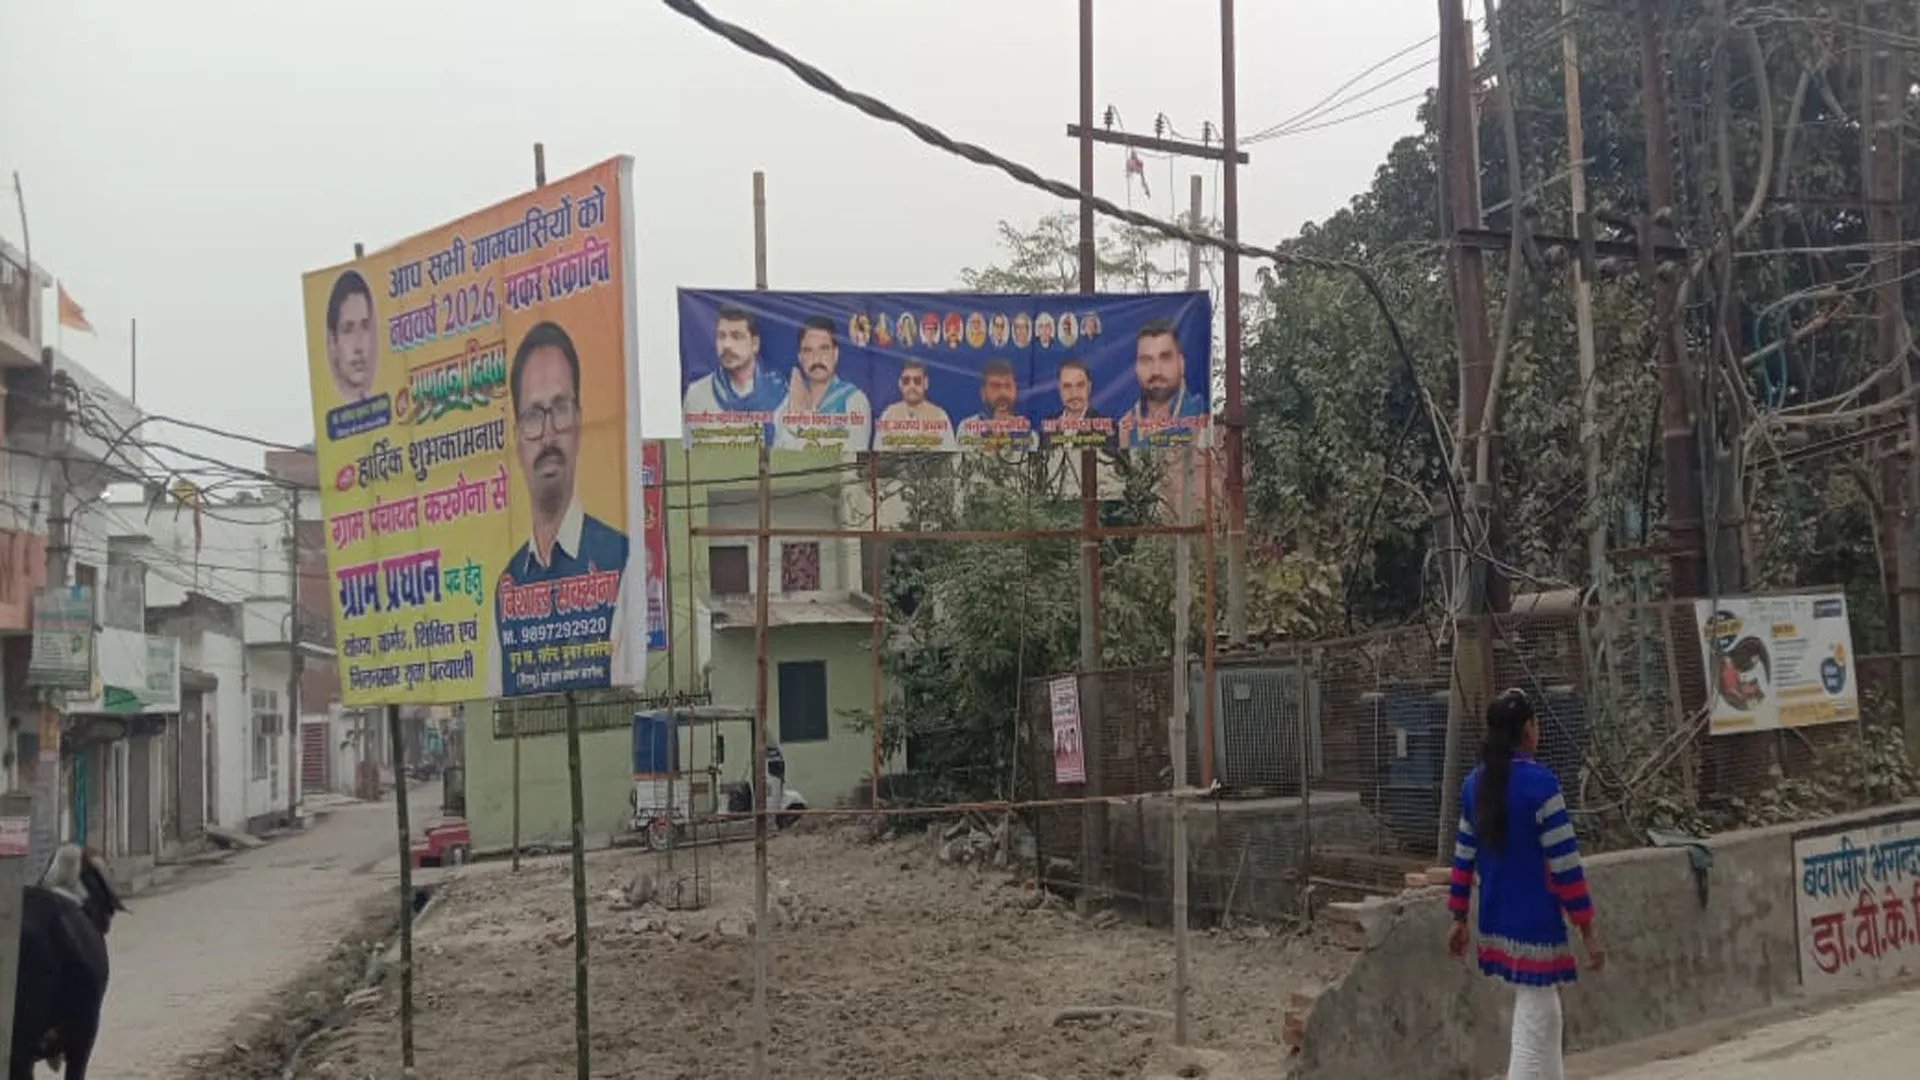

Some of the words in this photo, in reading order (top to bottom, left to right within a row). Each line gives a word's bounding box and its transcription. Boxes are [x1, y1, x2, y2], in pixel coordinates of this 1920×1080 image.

[388, 260, 423, 299] आप
[428, 237, 466, 287] सभी
[471, 194, 572, 270] ग्रामवासियों
[577, 185, 605, 230] को
[388, 295, 437, 350] नववर्ष
[503, 264, 544, 311] मकर
[356, 438, 403, 488] हार्दिक
[330, 511, 364, 549] ग्राम
[369, 496, 418, 535] पंचायत
[491, 465, 507, 509] से
[336, 563, 381, 619] ग्राम
[382, 549, 441, 612] प्रधान
[444, 568, 460, 594] पद
[463, 556, 484, 606] हेतु
[414, 619, 455, 648] शिक्षित
[459, 614, 478, 643] एवं
[502, 630, 517, 646] M.
[522, 617, 607, 643] 9897292920
[429, 650, 474, 682] प्रत्याशी
[1803, 836, 1877, 900] बवासीर
[1869, 837, 1920, 882] भगन्द
